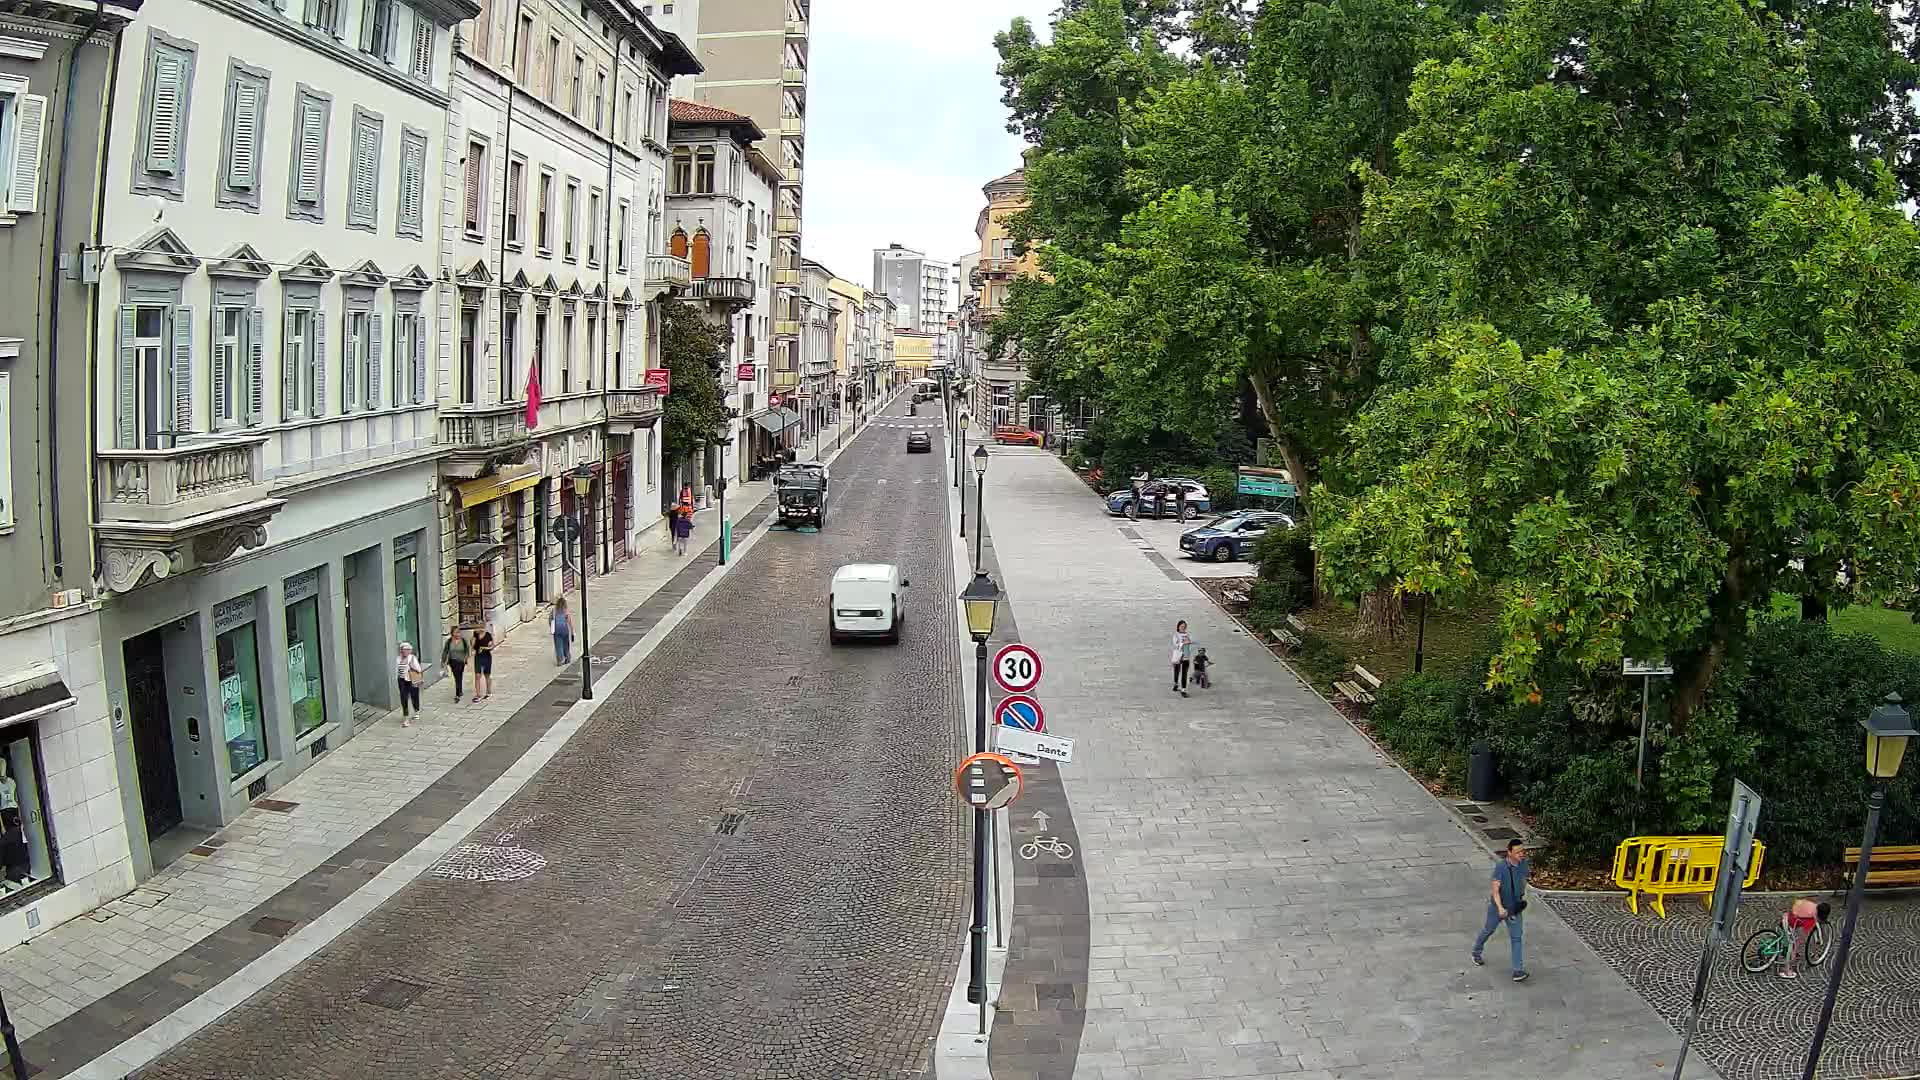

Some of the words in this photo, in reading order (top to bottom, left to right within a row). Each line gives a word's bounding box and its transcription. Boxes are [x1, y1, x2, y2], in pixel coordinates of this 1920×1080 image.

[1005, 658, 1031, 679] 30
[223, 678, 240, 698] 130
[1037, 743, 1067, 757] Dante
